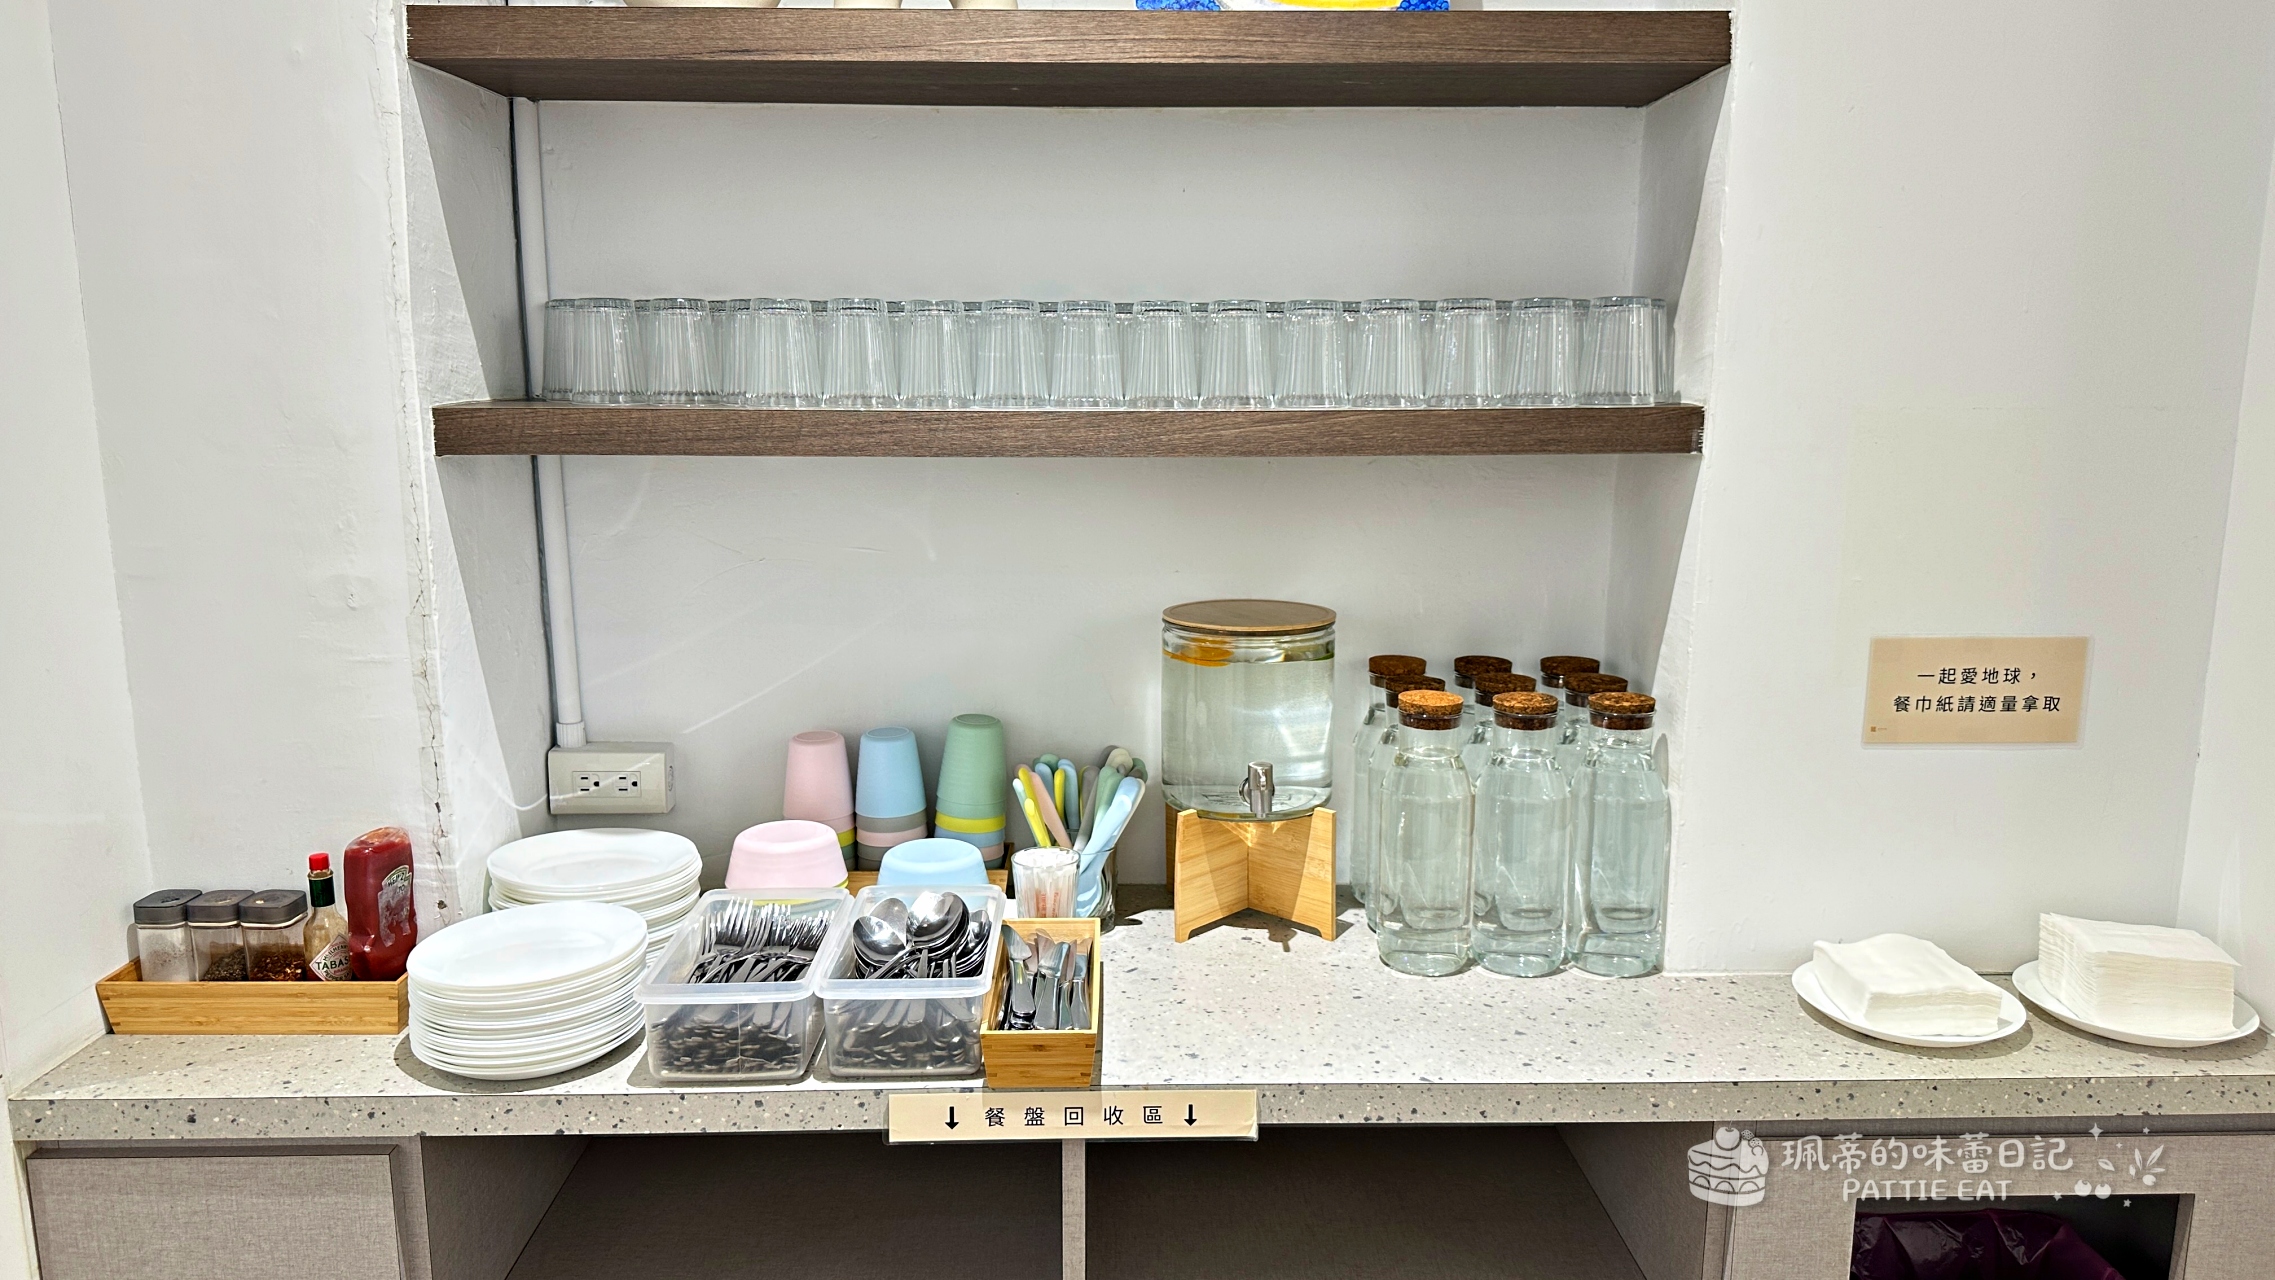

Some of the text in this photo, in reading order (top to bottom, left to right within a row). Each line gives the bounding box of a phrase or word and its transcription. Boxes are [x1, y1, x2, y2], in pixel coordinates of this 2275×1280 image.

[1917, 667, 2037, 685] 一起愛地球，
[1893, 695, 2061, 713] 餐巾紙請適量拿取
[315, 955, 349, 970] TABAS
[984, 1105, 1164, 1127] 餐盤回收區
